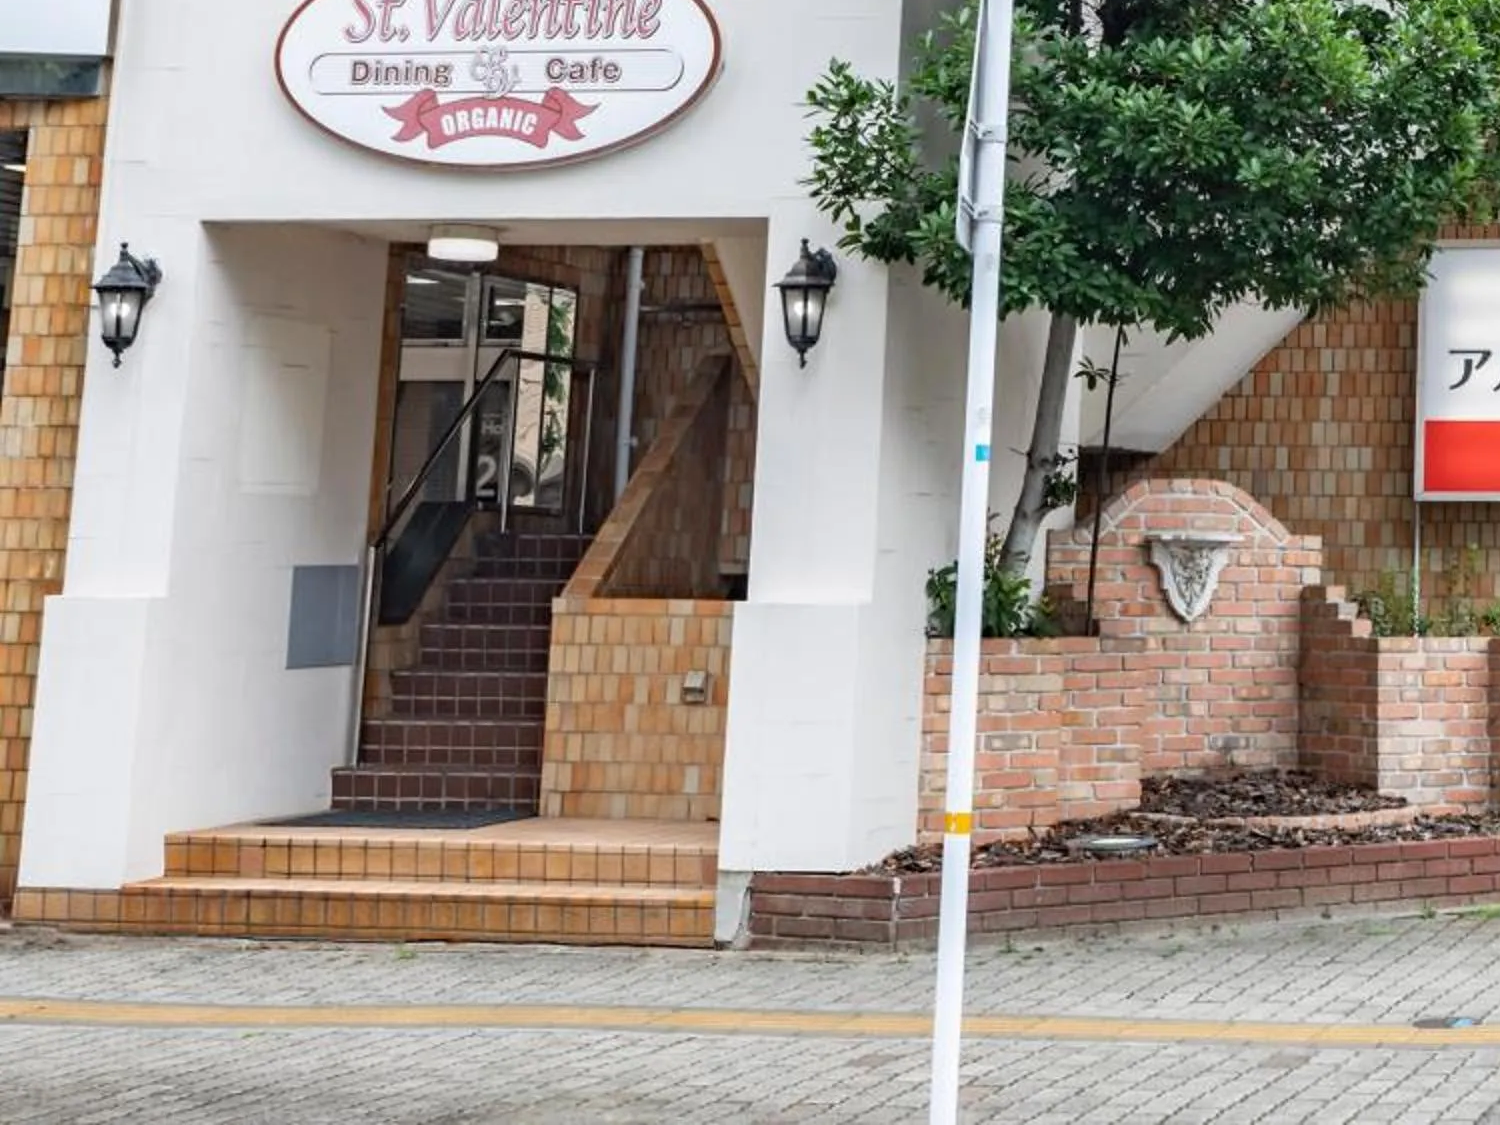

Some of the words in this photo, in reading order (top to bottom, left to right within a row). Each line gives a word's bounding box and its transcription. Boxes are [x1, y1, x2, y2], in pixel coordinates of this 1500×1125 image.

[351, 59, 452, 87] Dining
[546, 57, 622, 84] Cafe
[440, 104, 538, 138] ORGANIC
